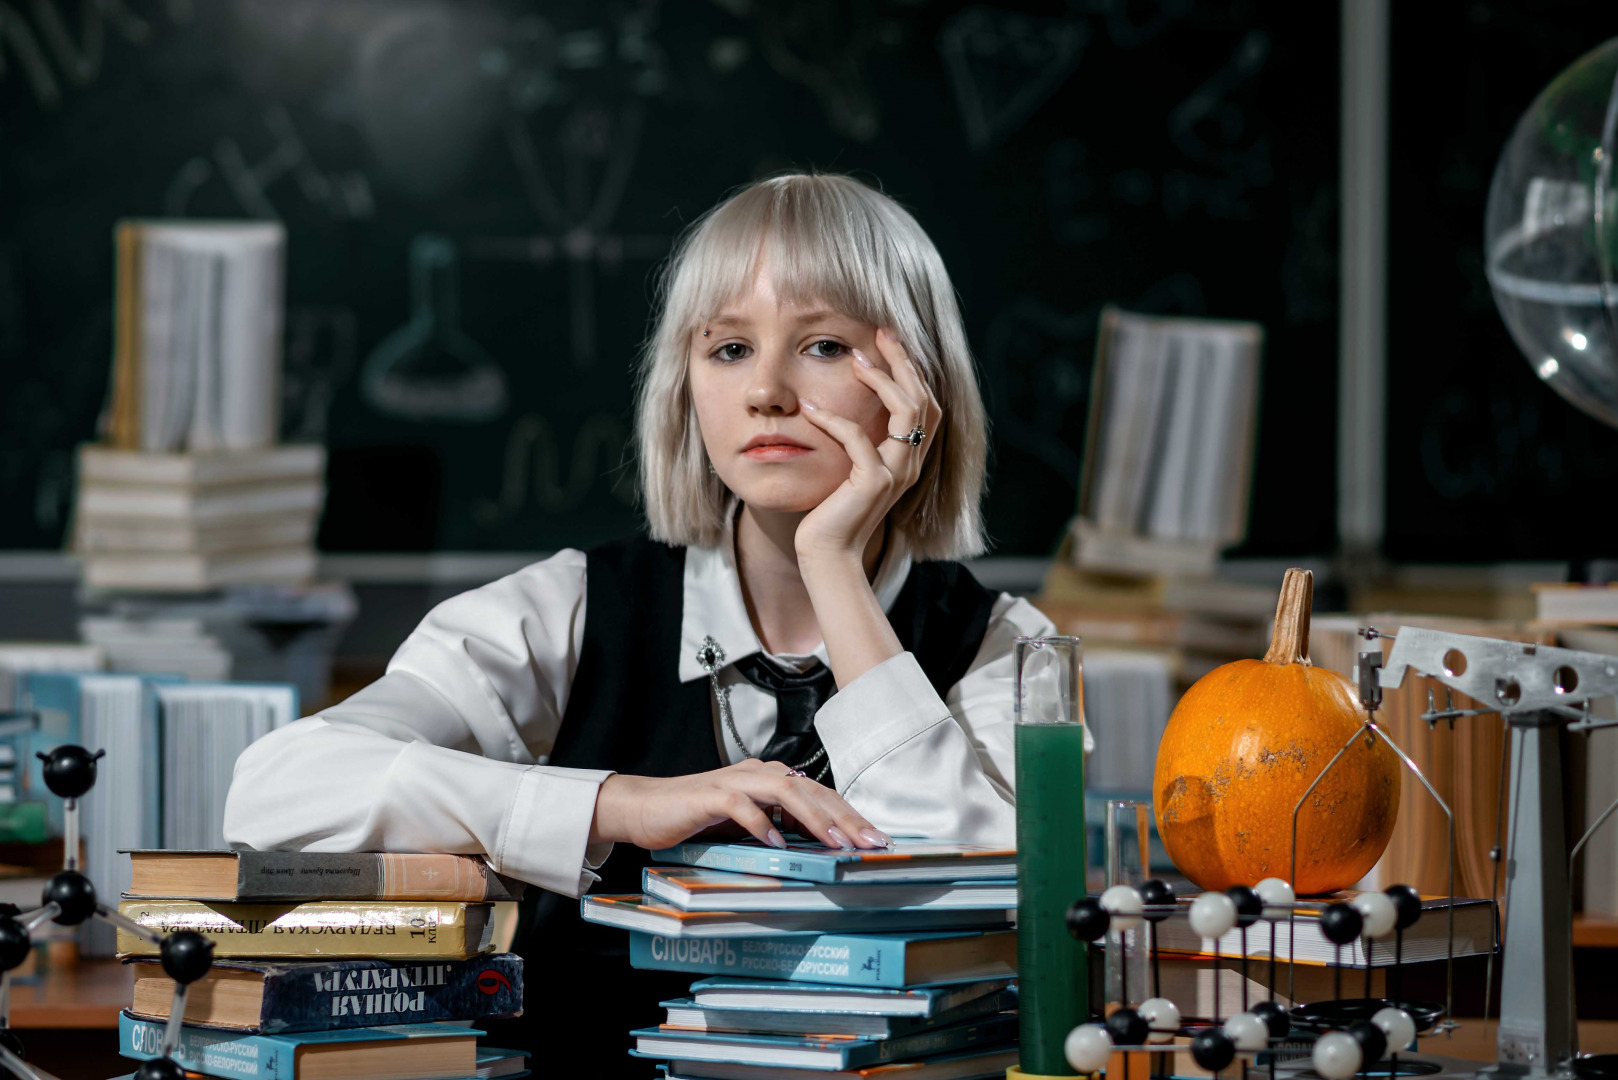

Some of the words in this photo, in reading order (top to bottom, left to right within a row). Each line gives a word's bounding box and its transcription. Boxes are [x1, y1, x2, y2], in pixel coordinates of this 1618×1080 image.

[409, 918, 426, 939] 10
[651, 935, 736, 966] СЛОВАРЬ
[742, 940, 850, 960] БЕЛОРУССКО-РУССКИЙ
[313, 965, 452, 992] ЛІТАРАТУРА
[741, 957, 849, 977] РУССКО-БЕЛОРУССКИЙ
[331, 988, 425, 1017] РОДНАЯ
[132, 1024, 186, 1060] СЛОВЬ
[190, 1035, 259, 1058] БЕЛОРУССКО-РУССКИЙ
[189, 1051, 258, 1075] РУССКО-БЕЛОРУССКИЙ
